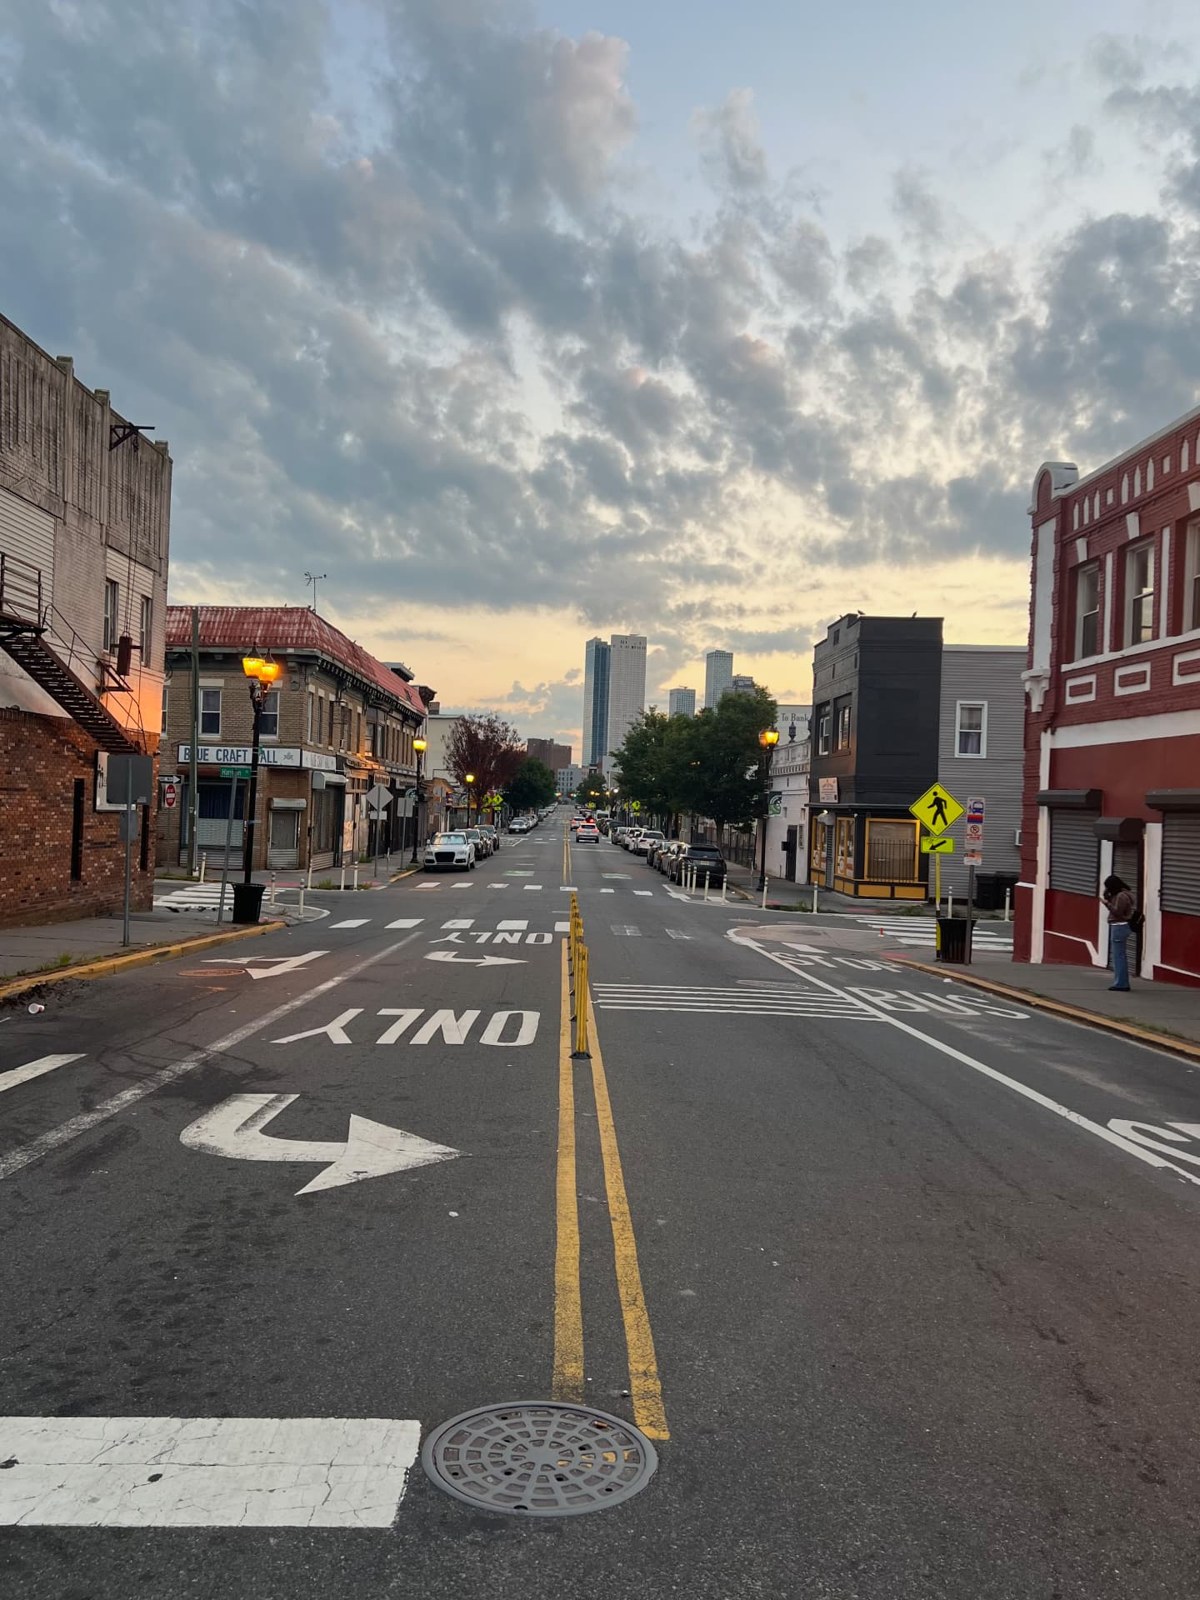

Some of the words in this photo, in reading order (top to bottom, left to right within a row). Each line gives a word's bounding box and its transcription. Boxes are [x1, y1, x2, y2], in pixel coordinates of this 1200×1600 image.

[781, 712, 789, 721] To
[184, 747, 209, 761] BUE
[216, 748, 248, 763] CRAFT
[259, 749, 278, 764] ALL
[428, 931, 554, 945] ONLY
[770, 951, 903, 973] STOP
[843, 986, 1031, 1020] BUS
[269, 1008, 541, 1047] ONLY
